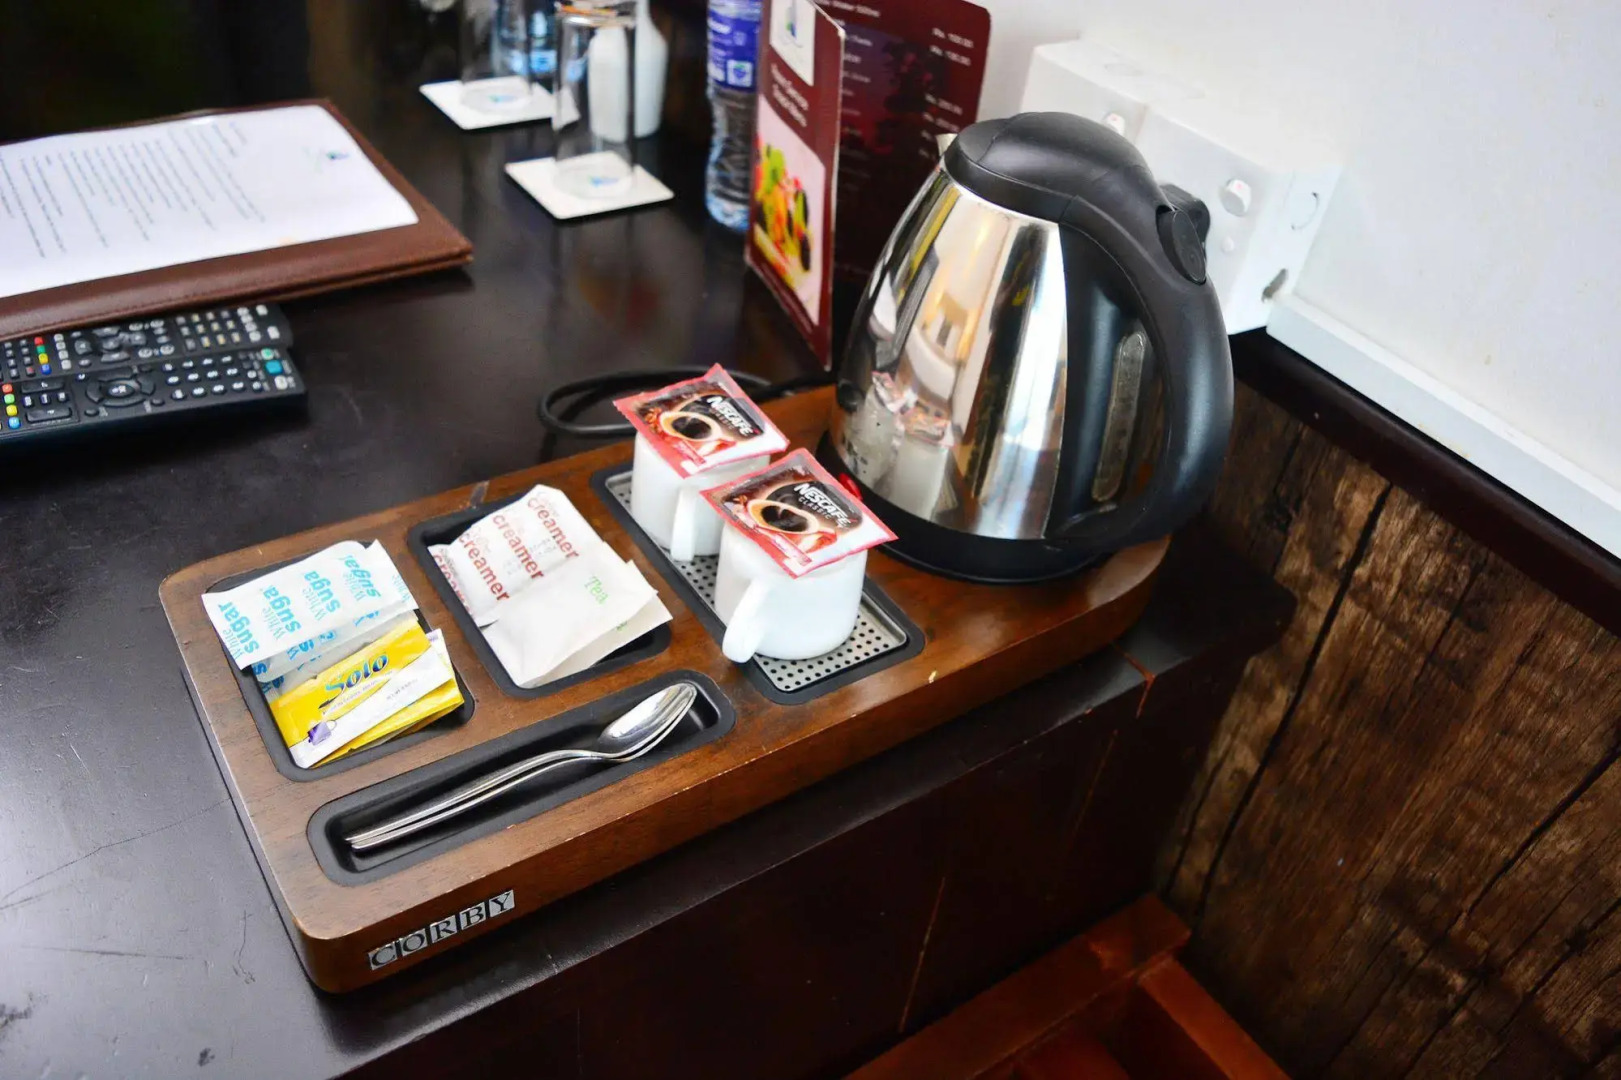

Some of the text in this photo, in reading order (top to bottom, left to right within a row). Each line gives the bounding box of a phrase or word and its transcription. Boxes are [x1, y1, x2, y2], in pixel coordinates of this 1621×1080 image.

[492, 514, 545, 580] creamer
[527, 497, 580, 559] creamer
[458, 533, 511, 601] creamer
[584, 575, 609, 606] Tea
[218, 601, 260, 653] sugar
[222, 628, 245, 661] White
[262, 606, 286, 640] White
[371, 889, 514, 967] CORBY
